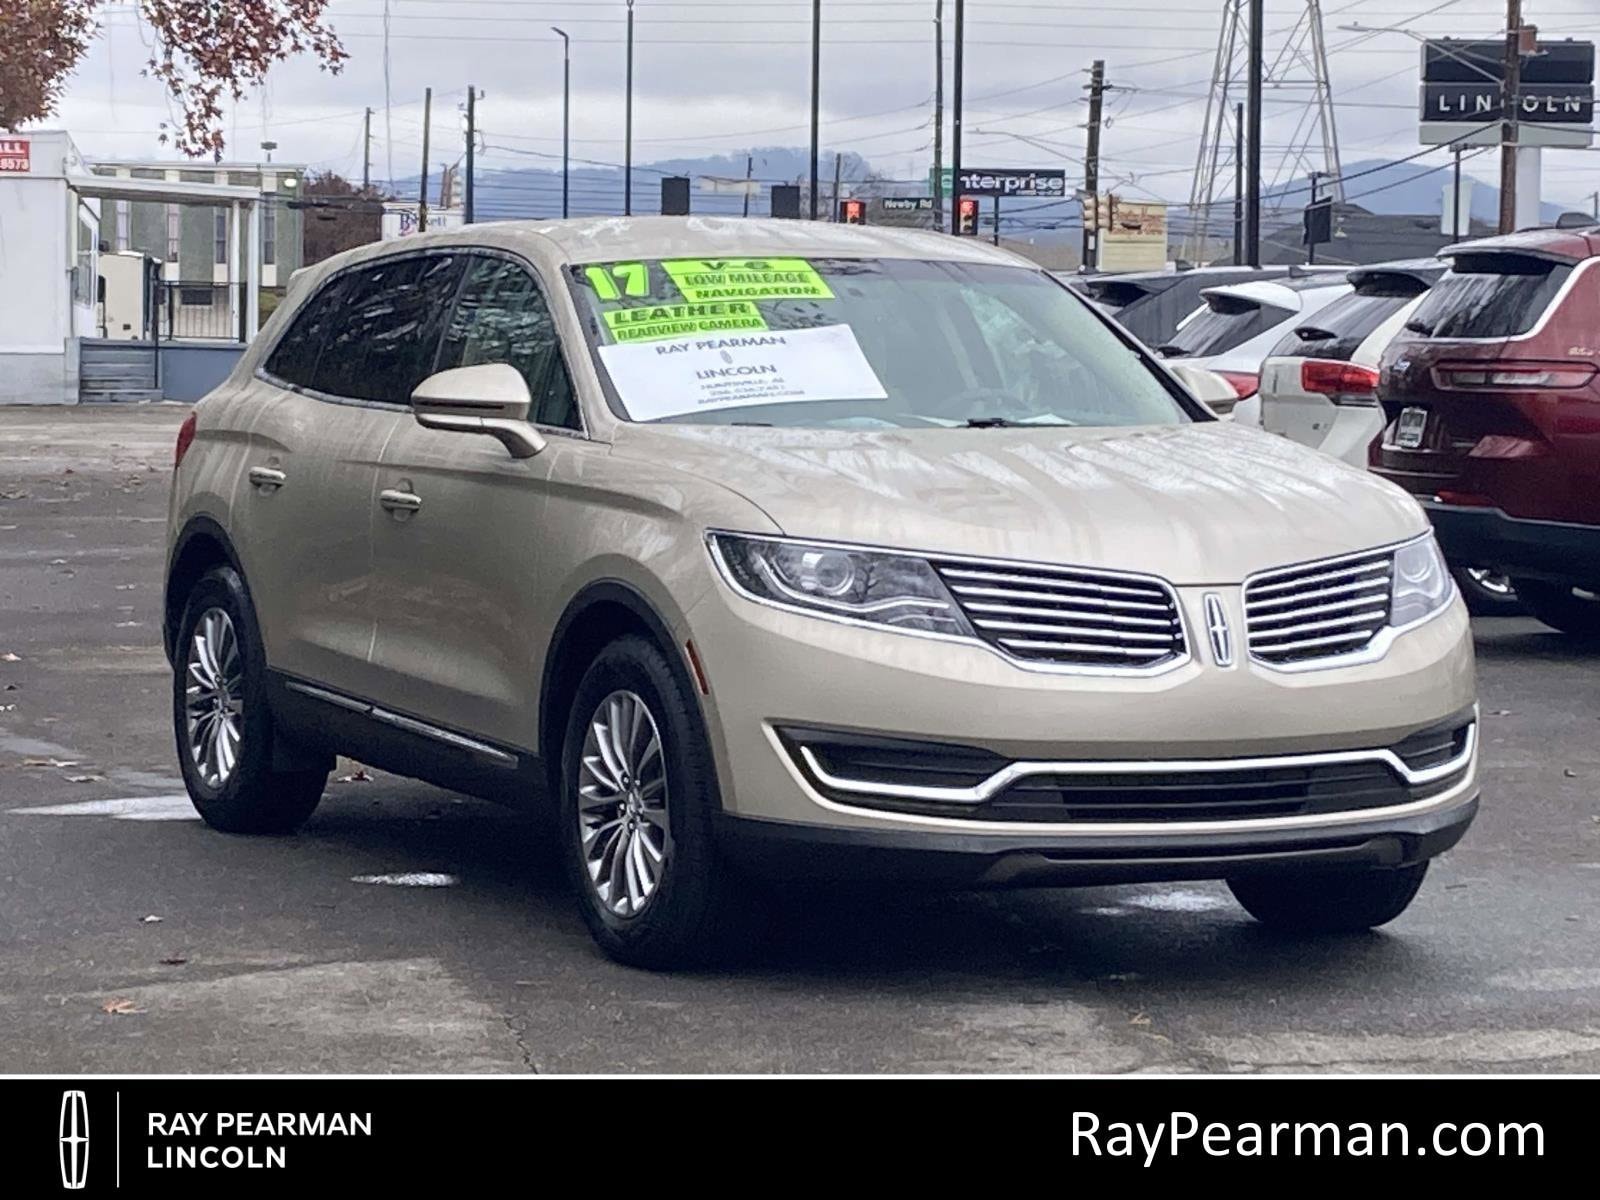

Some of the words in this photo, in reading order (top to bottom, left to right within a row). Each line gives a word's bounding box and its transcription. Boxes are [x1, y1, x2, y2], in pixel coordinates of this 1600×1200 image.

[1438, 95, 1581, 112] LINOLN
[920, 199, 932, 208] Rd
[585, 262, 650, 302] 17
[685, 271, 726, 286] LOW
[728, 270, 811, 284] MILEAGE
[695, 286, 820, 299] NAVIGATION
[613, 302, 752, 325] LEATHER
[616, 322, 697, 341] REARVIEW
[698, 318, 763, 331] CAMERA
[656, 341, 690, 355] RAY
[696, 335, 787, 351] PEARMAN
[696, 364, 777, 380] LINCOLN
